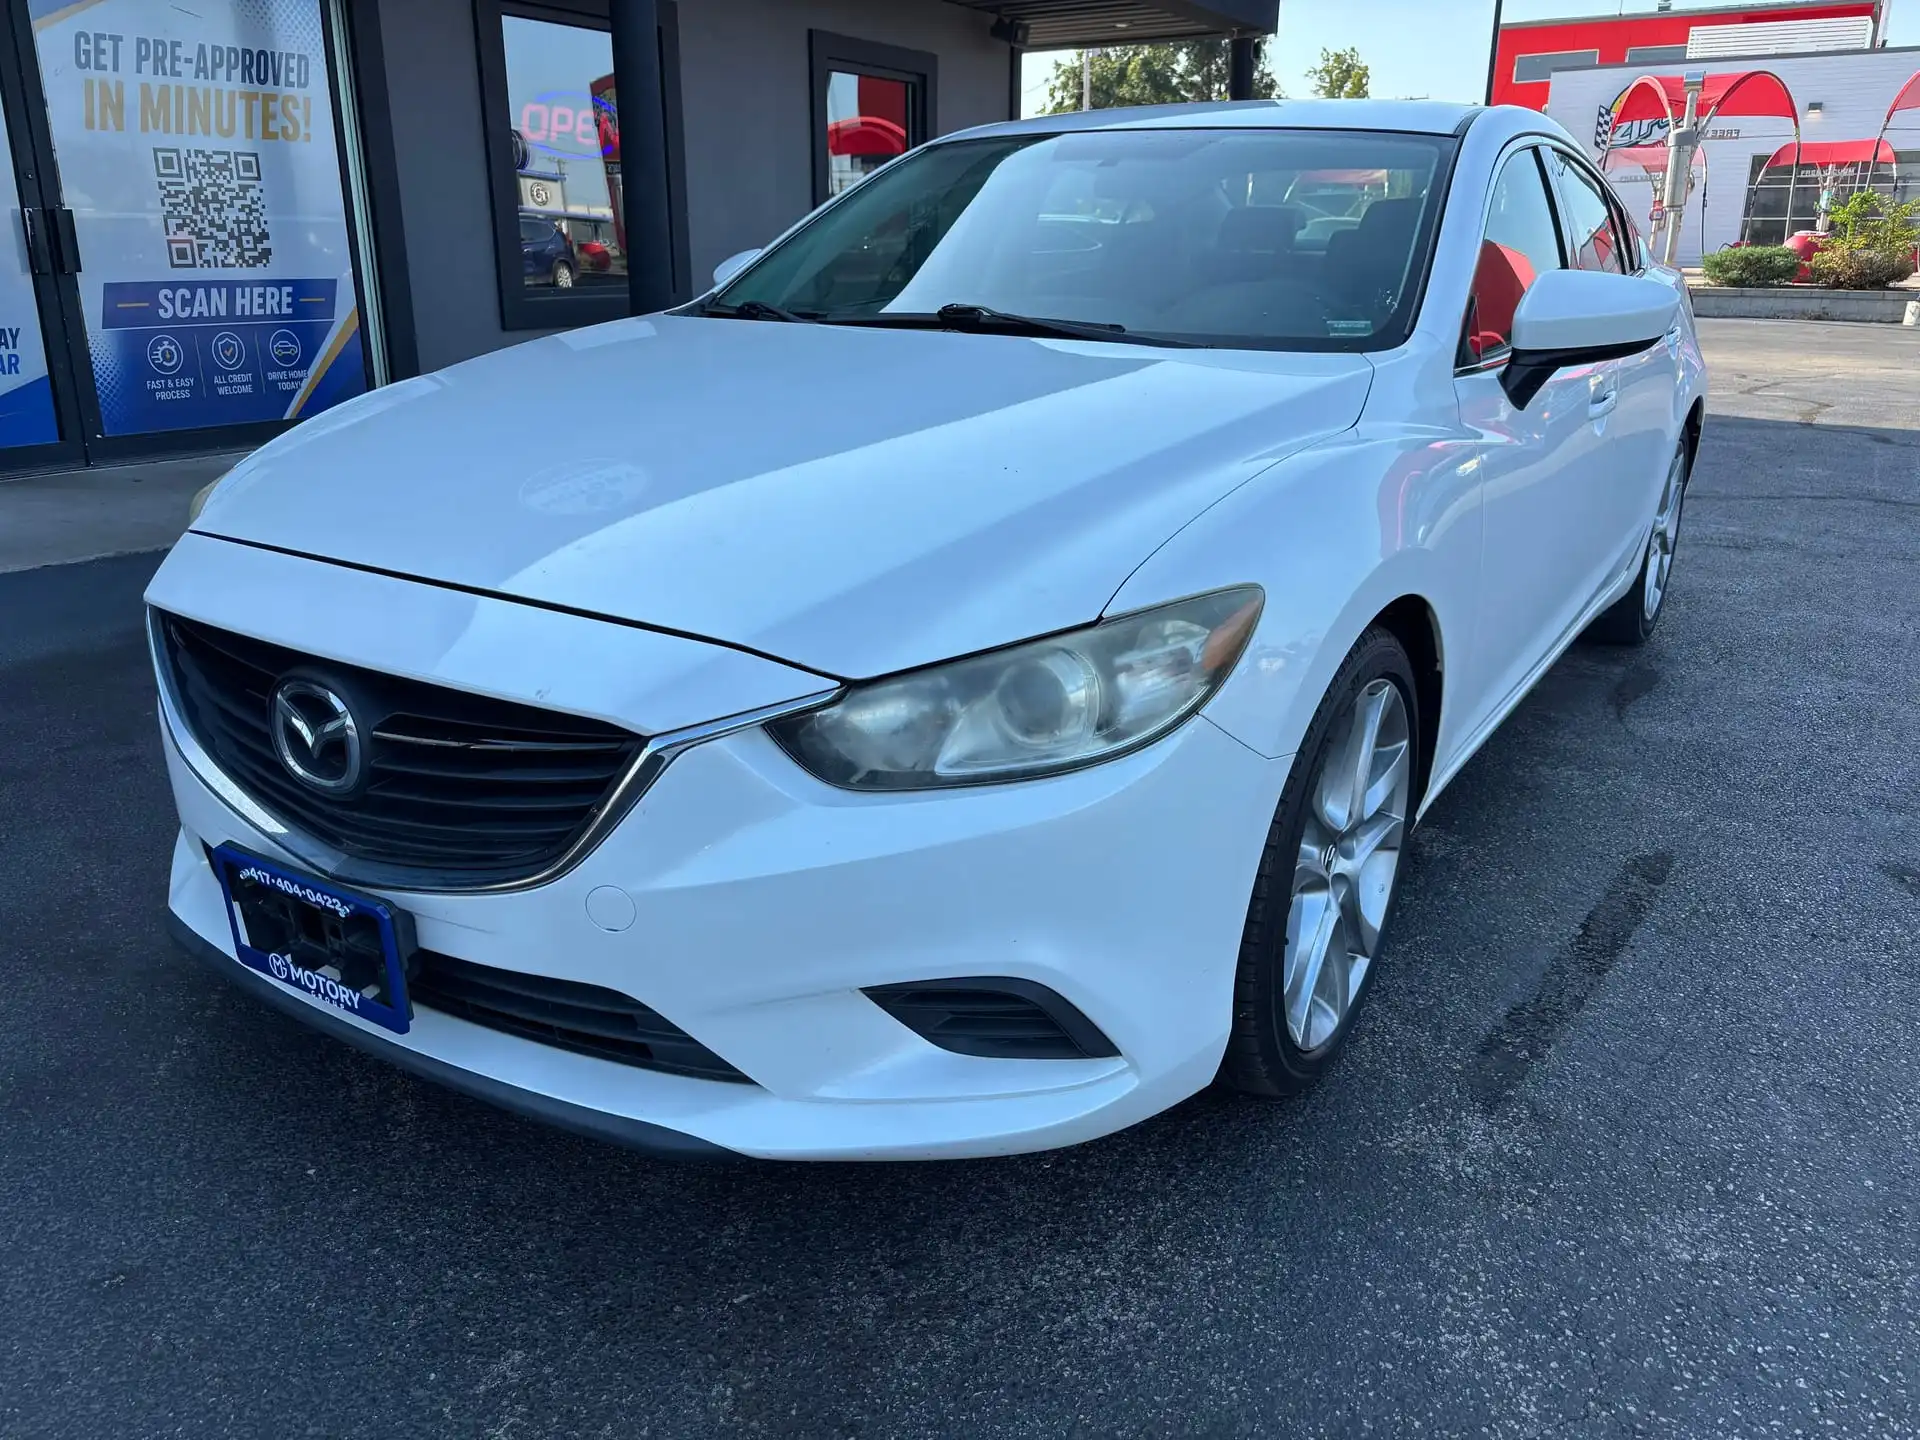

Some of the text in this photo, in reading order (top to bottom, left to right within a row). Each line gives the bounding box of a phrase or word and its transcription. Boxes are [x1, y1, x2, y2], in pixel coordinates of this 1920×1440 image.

[74, 30, 310, 89] GET PRE-APPROVED
[84, 77, 312, 143] IN MINUTES!
[521, 103, 619, 149] OPEN
[158, 286, 294, 319] SCAN HERE
[146, 377, 195, 391] FAST & EASY
[213, 373, 253, 385] ALL CREDIT
[267, 369, 308, 380] DRIVE HOME
[155, 389, 191, 401] PROCESS
[217, 384, 253, 396] WELCOME
[289, 963, 360, 1009] MOTORY
